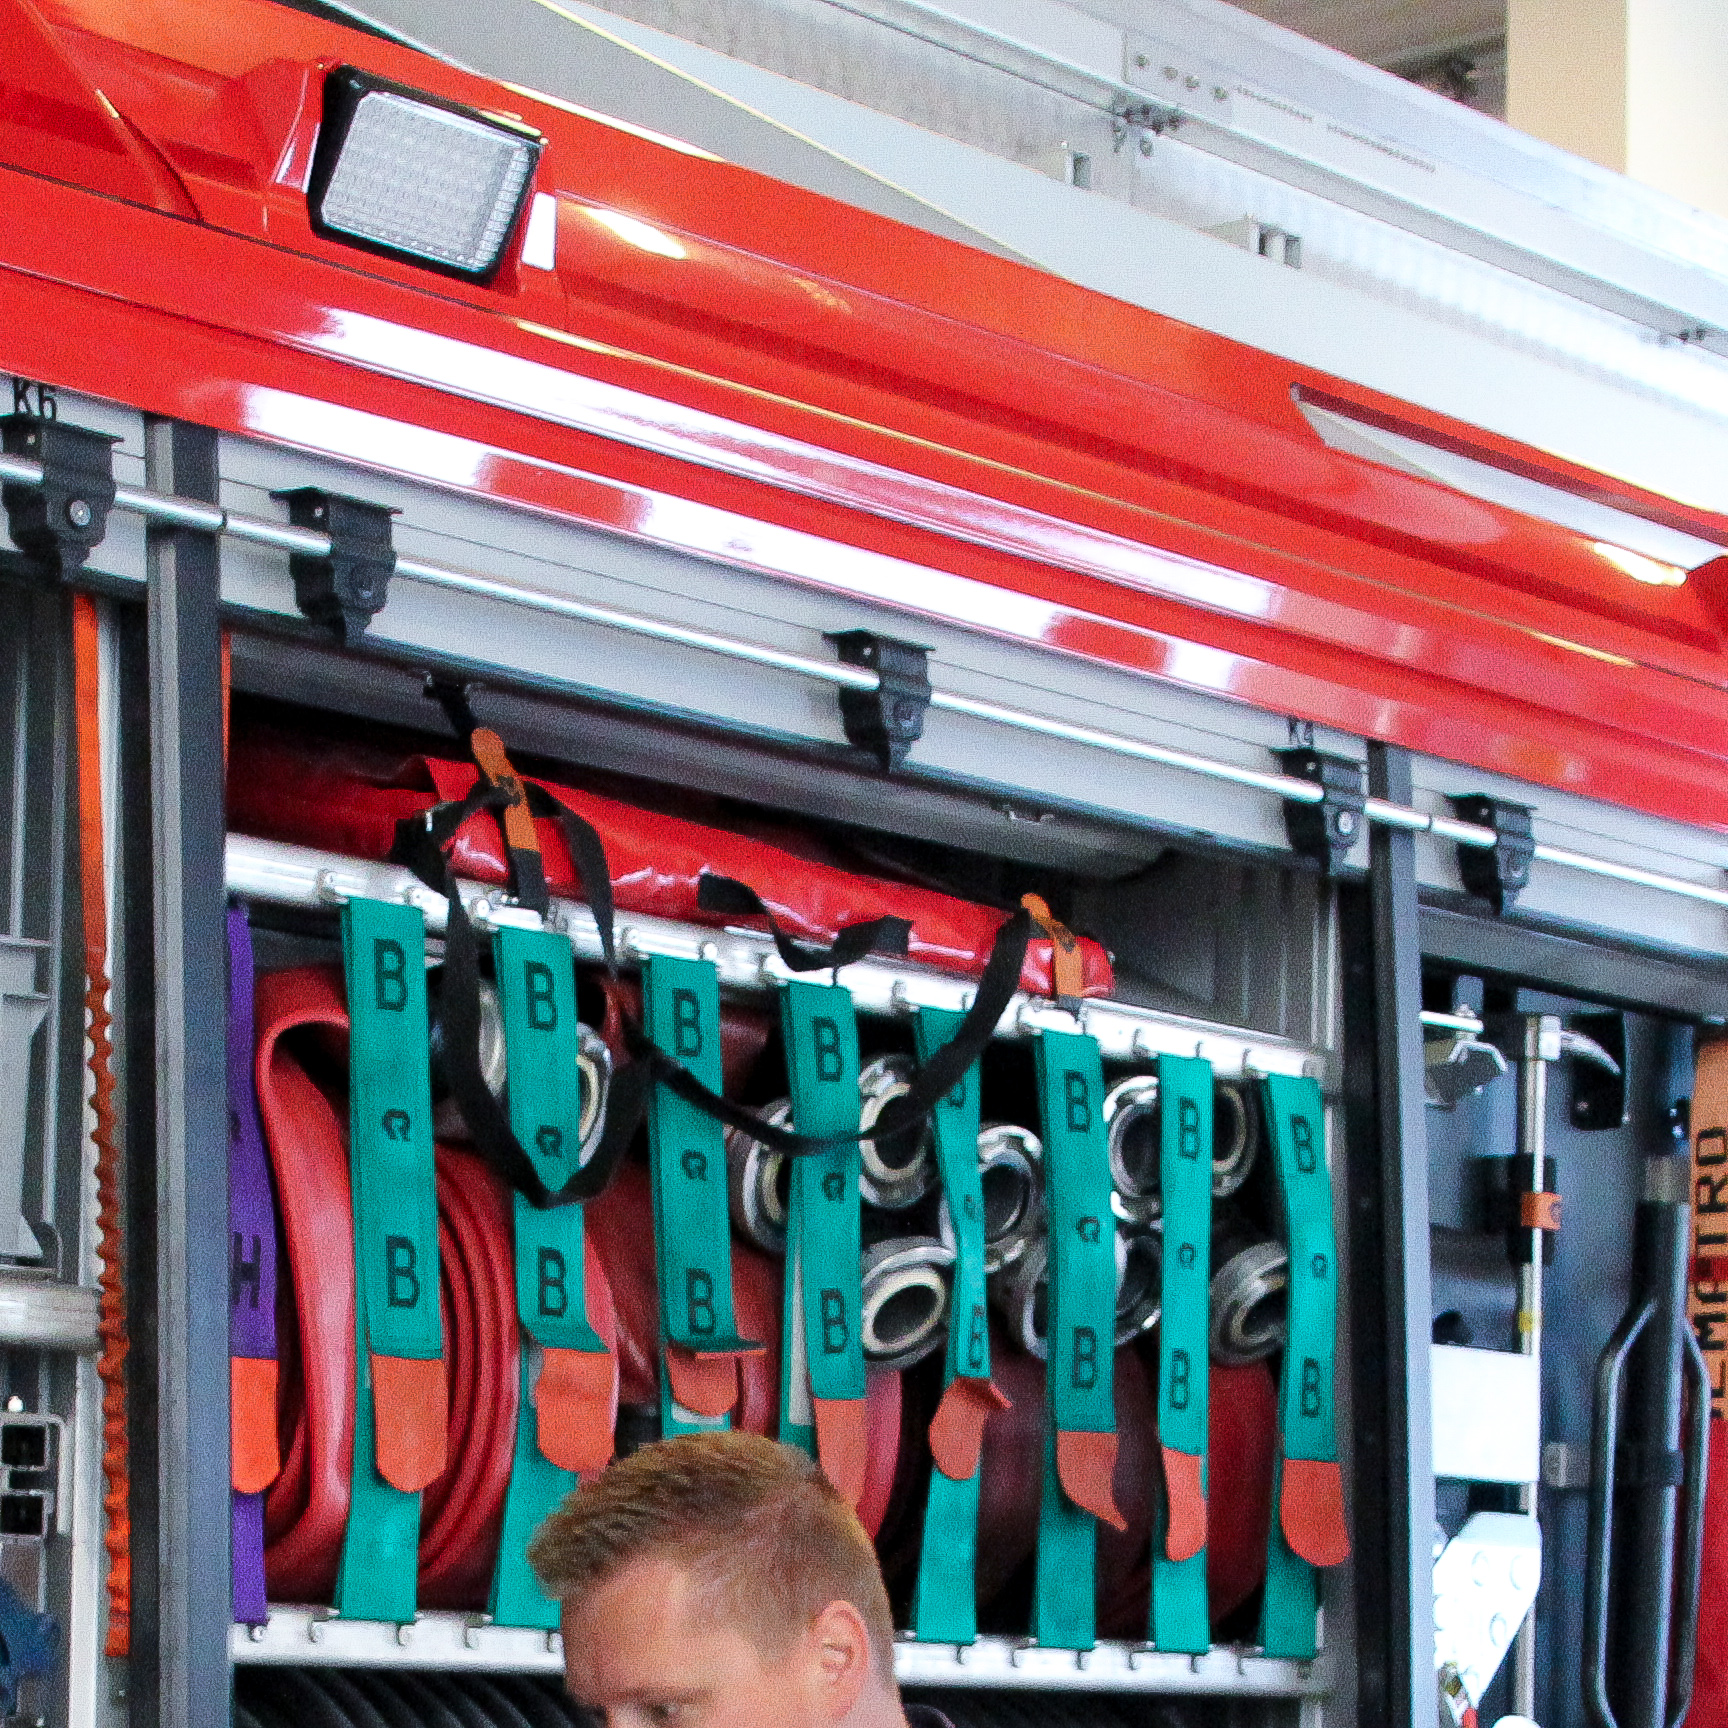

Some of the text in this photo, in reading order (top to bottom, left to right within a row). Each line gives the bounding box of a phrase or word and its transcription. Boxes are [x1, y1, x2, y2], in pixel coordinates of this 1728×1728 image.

[374, 938, 420, 1309] B B
[525, 960, 570, 1318] B B
[673, 988, 717, 1335] B B
[813, 1016, 850, 1354] B B
[1065, 1071, 1100, 1390] B B
[1169, 1098, 1201, 1410] B B
[1292, 1115, 1323, 1418] B B
